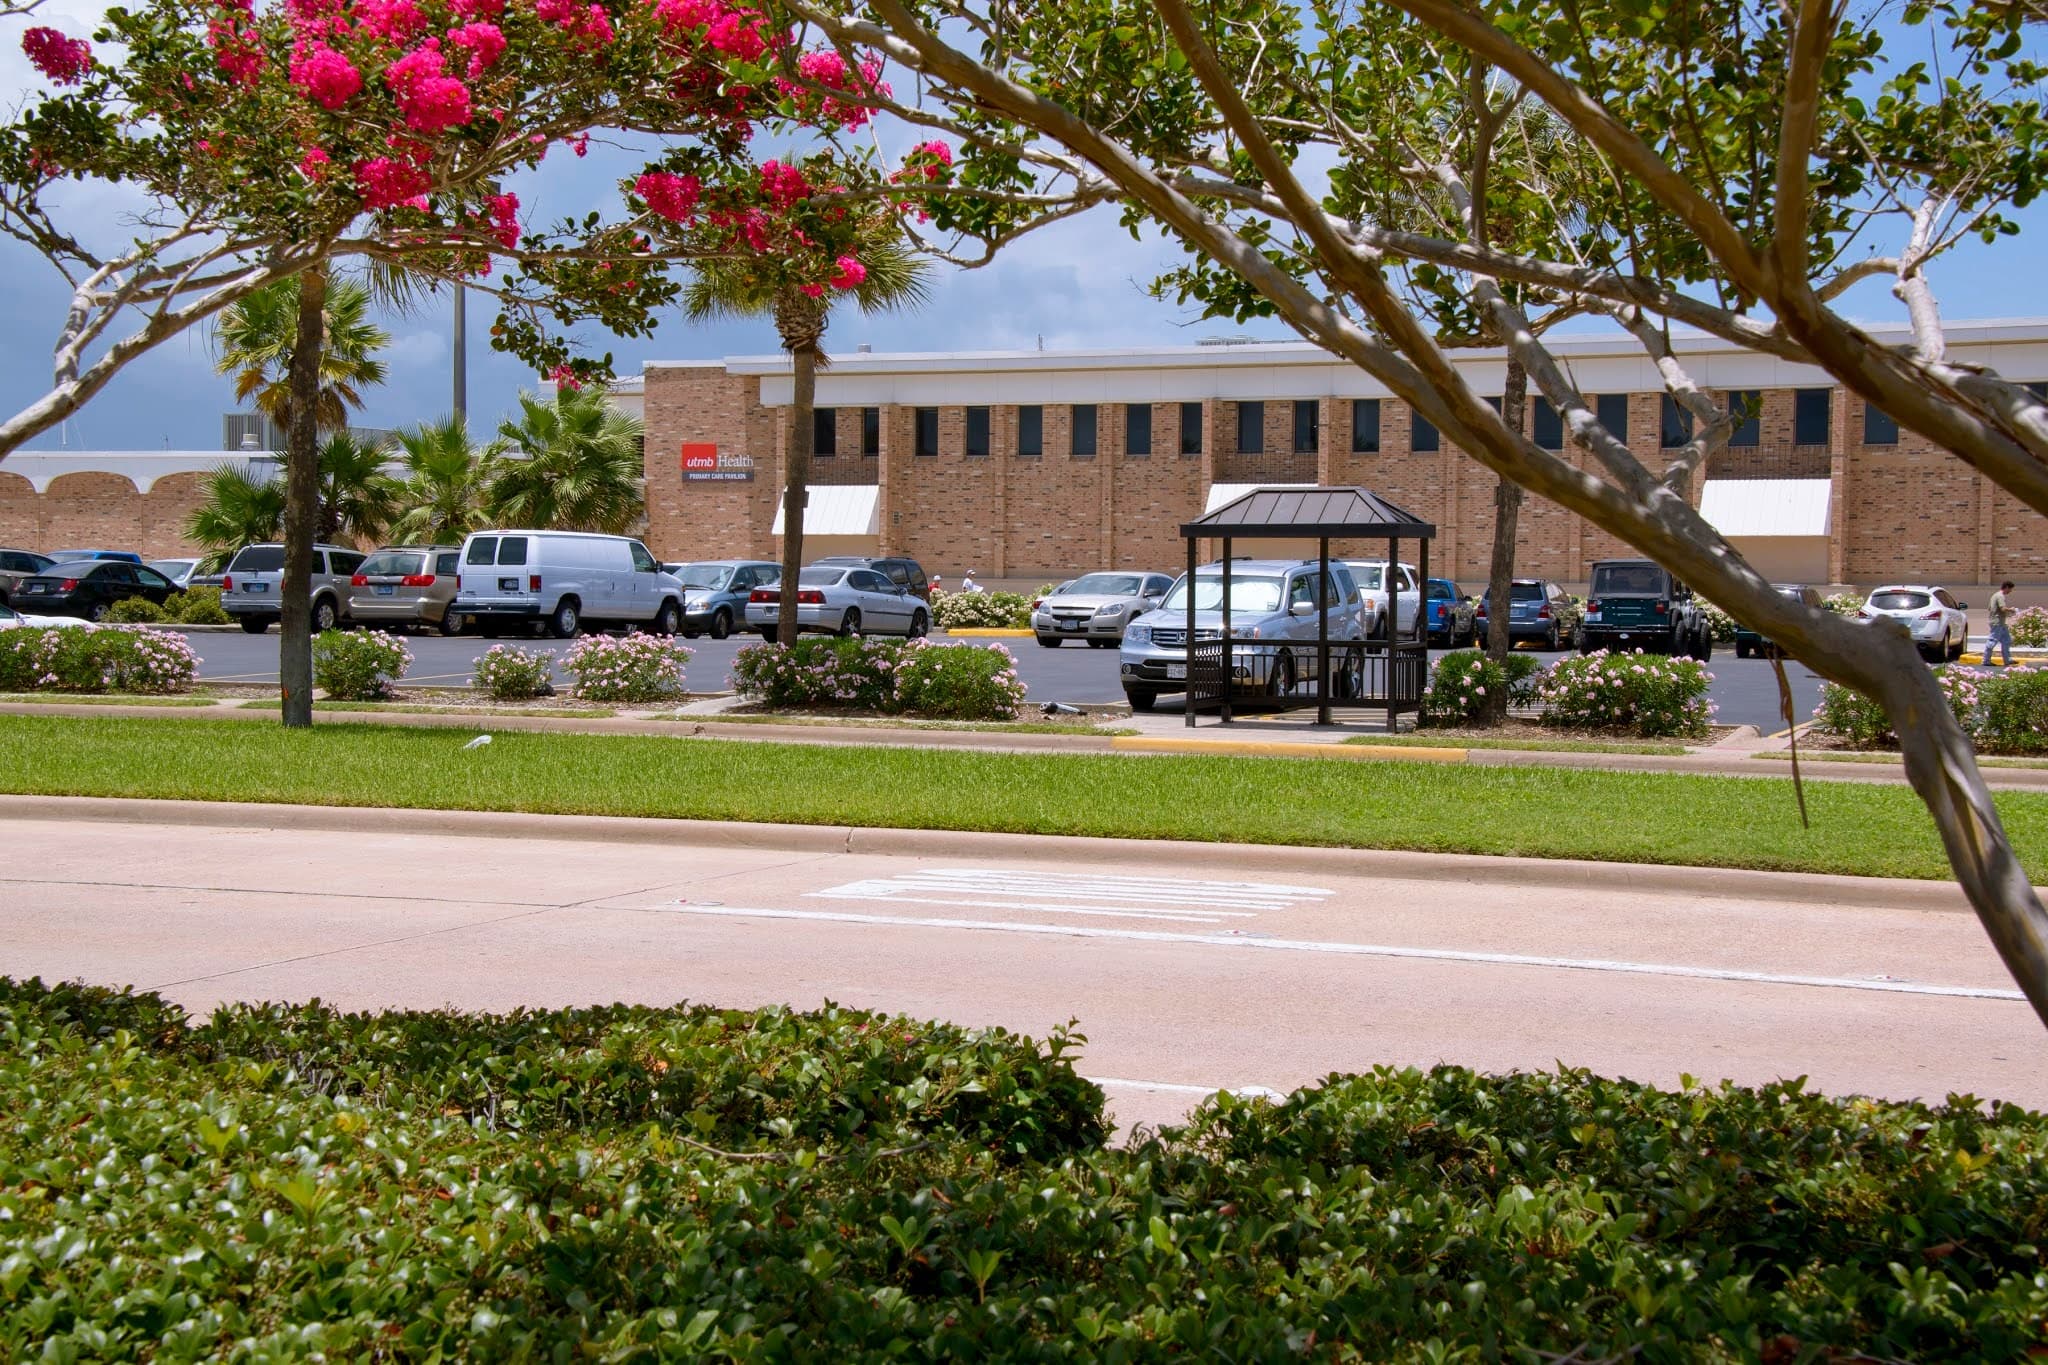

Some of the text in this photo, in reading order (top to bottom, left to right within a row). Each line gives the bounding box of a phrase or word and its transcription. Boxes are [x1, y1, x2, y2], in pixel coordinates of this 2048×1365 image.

[687, 455, 754, 467] utmb Health
[798, 868, 1337, 923] ONLY
